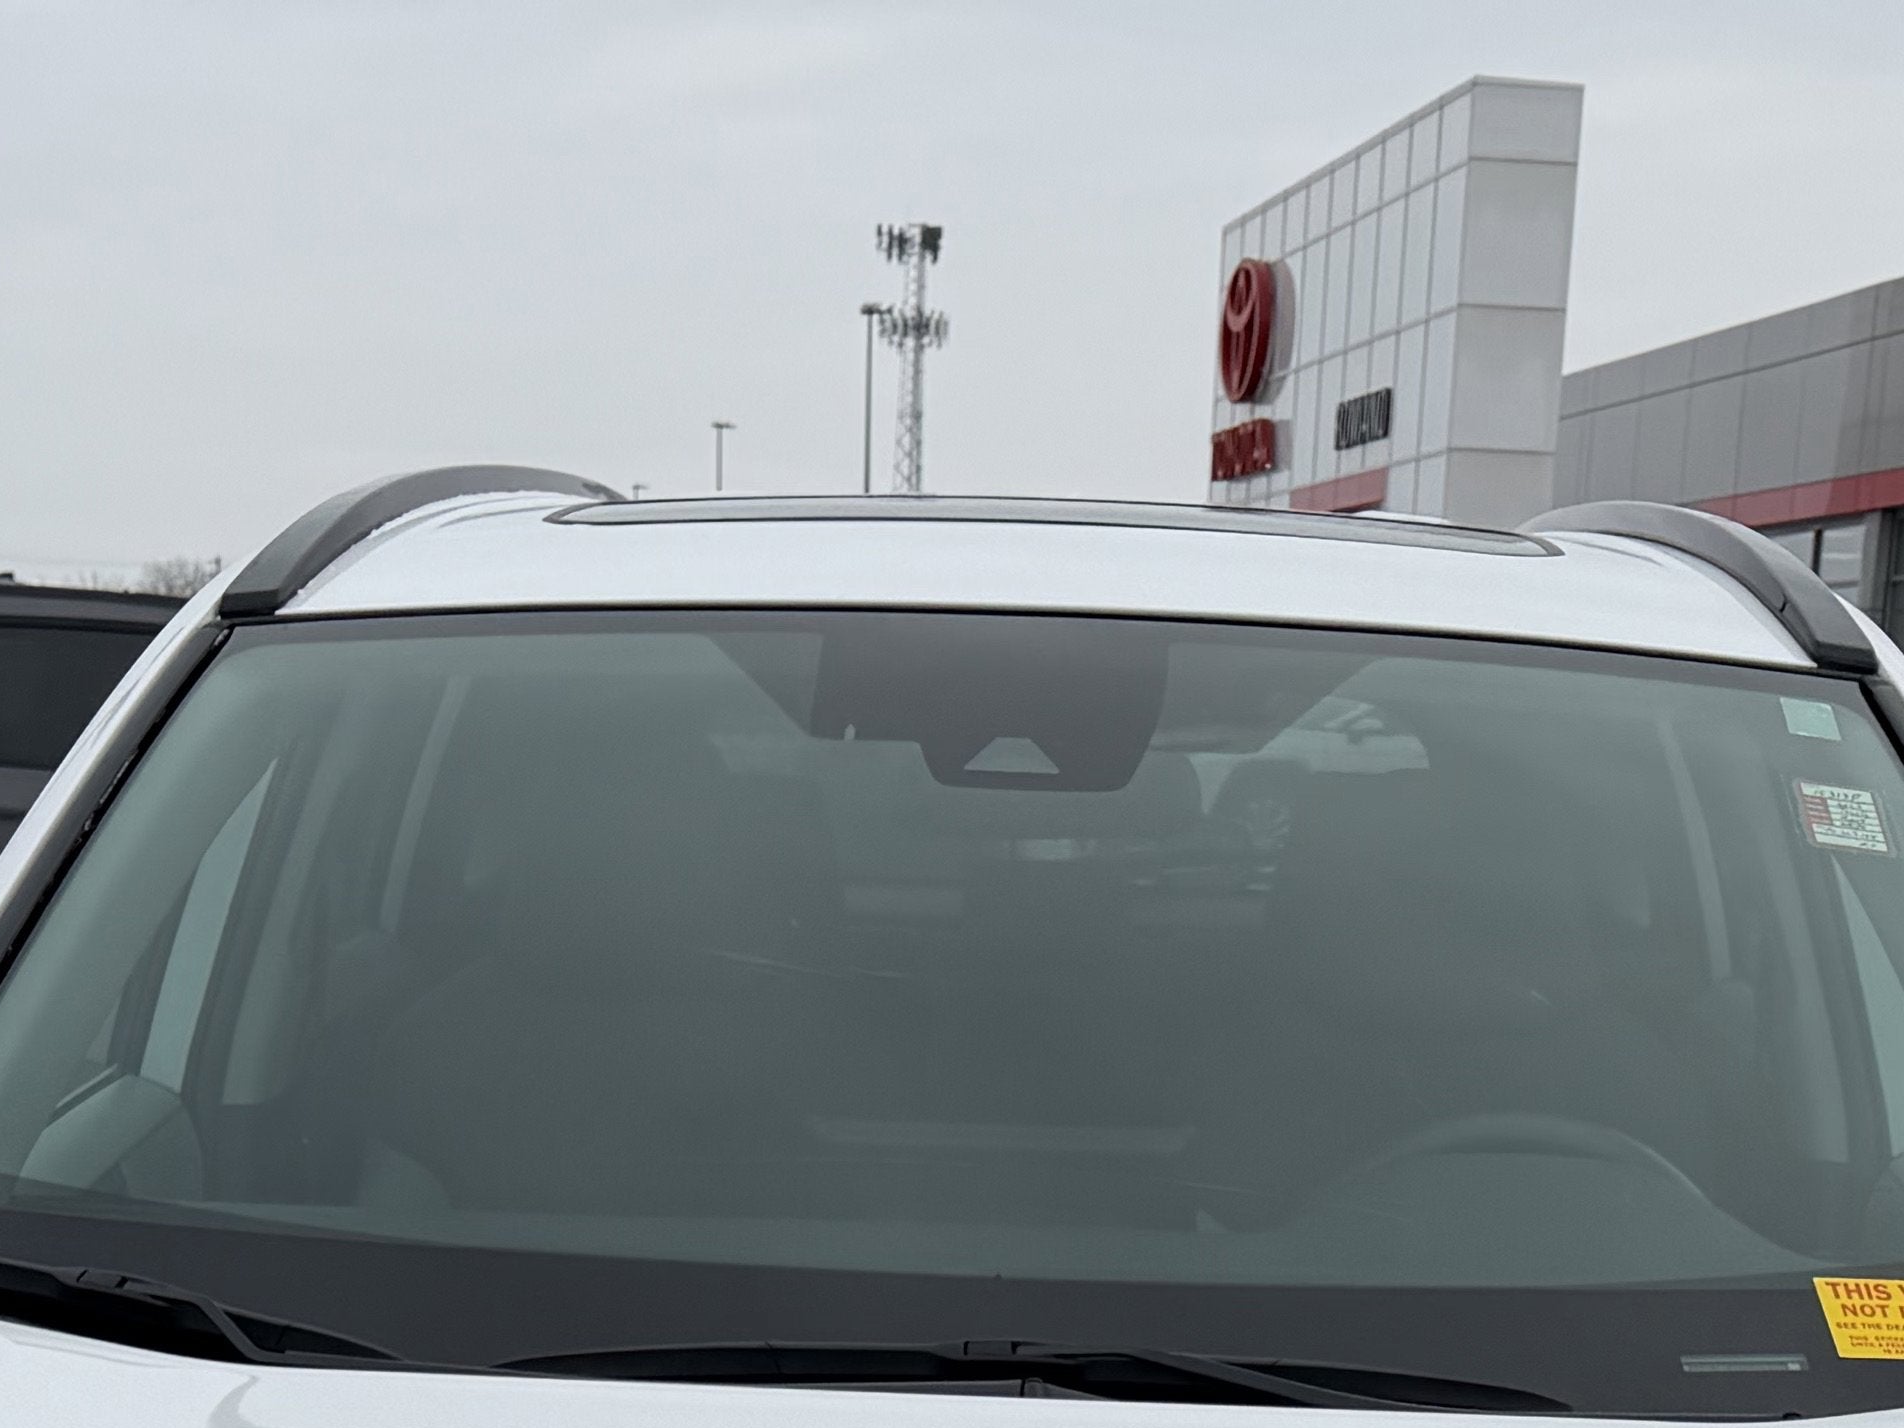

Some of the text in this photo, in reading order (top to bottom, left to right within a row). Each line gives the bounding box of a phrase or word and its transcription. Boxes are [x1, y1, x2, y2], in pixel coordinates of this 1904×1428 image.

[1824, 1281, 1893, 1301] THIS
[1839, 1302, 1893, 1318] NOT
[1834, 1321, 1858, 1329] SEE
[1860, 1322, 1882, 1330] THE
